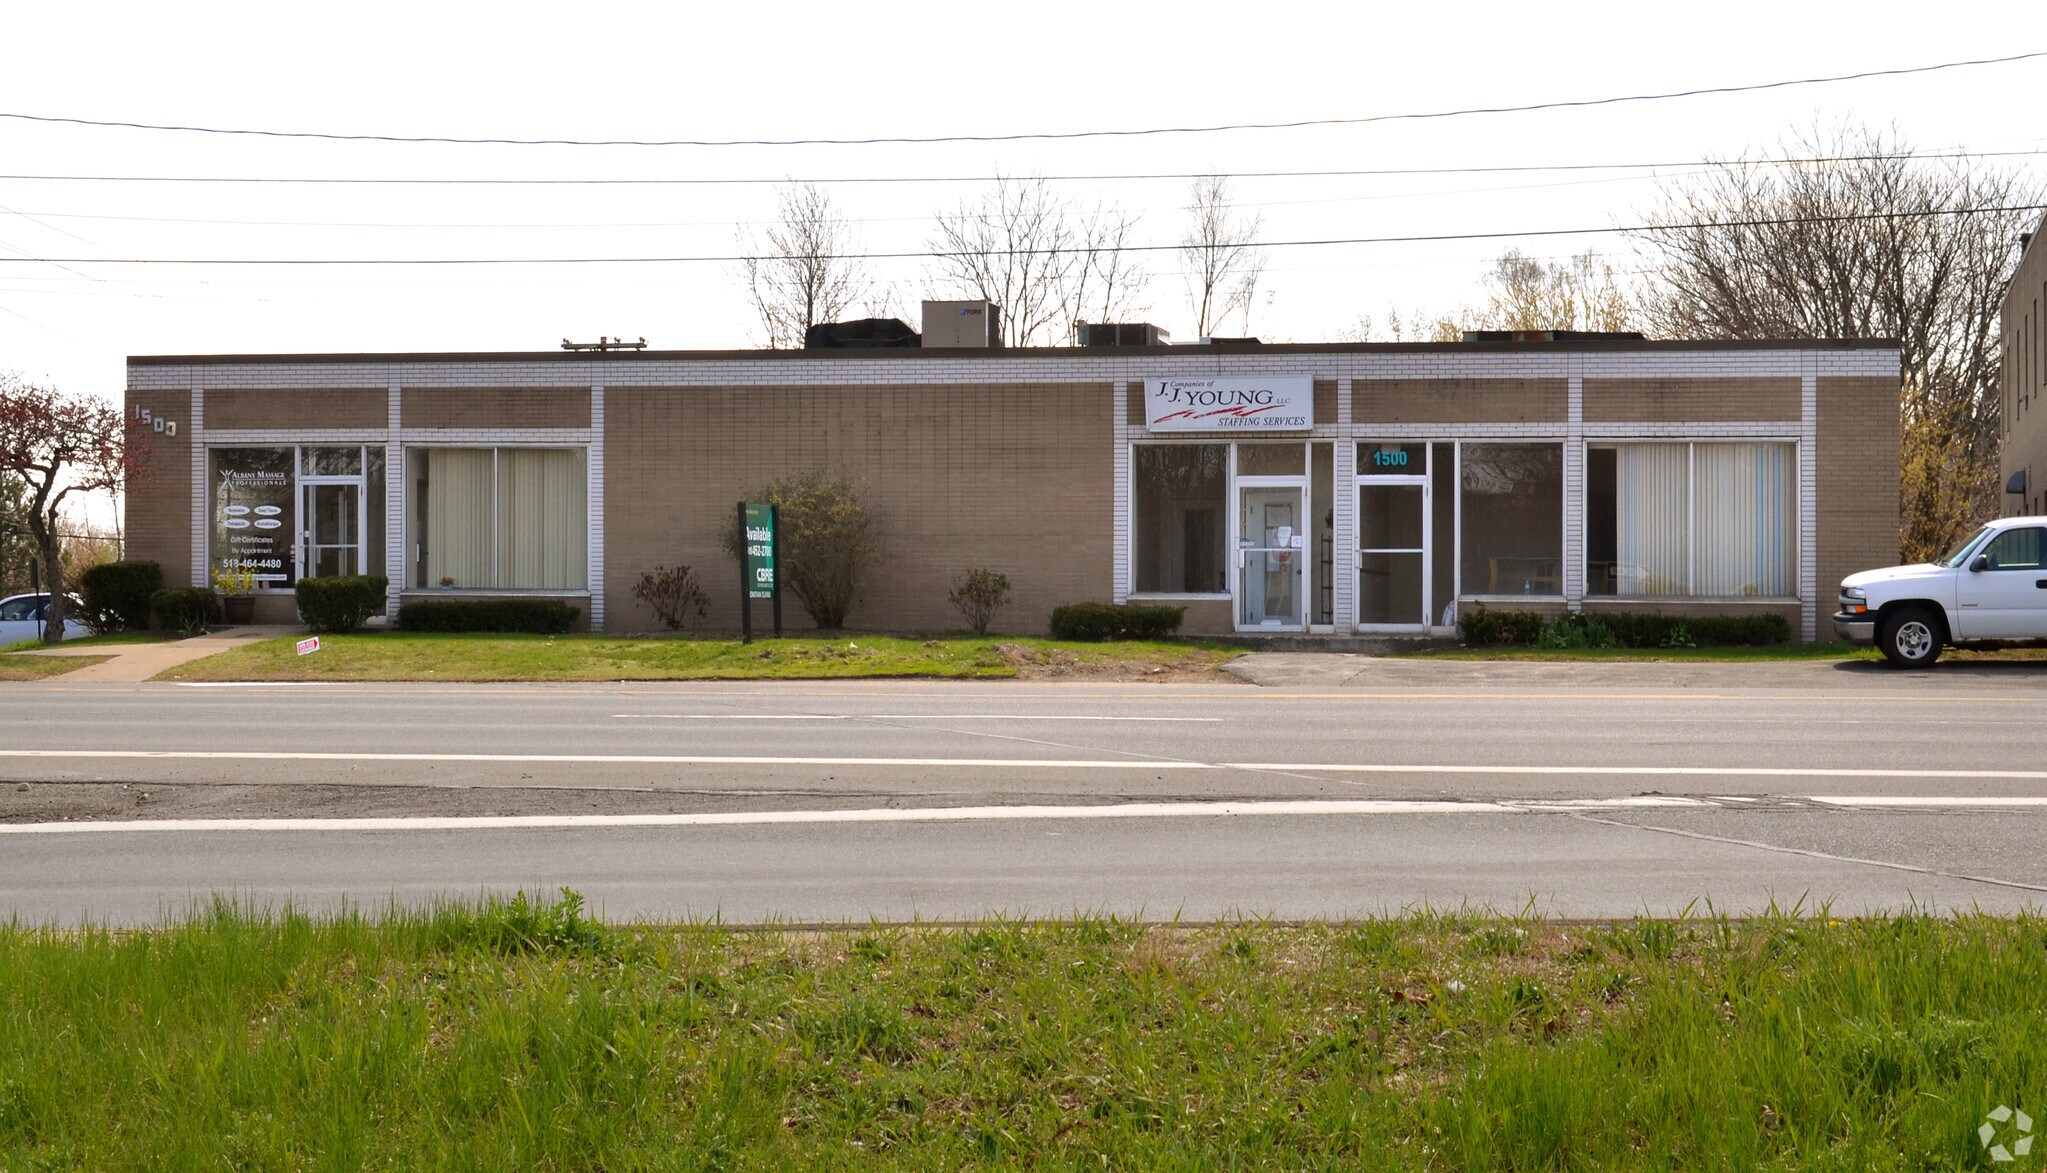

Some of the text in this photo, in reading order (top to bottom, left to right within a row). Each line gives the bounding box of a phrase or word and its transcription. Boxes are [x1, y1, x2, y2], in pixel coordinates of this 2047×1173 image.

[1207, 380, 1214, 388] of
[135, 404, 176, 437] 1500
[1218, 416, 1305, 427] STAFFING SERVICES
[1374, 450, 1408, 466] 1500
[231, 536, 273, 544] Gift Certificates
[241, 547, 272, 555] Appointment
[223, 559, 282, 568] 518-464-4480
[756, 567, 774, 582] CBRE
